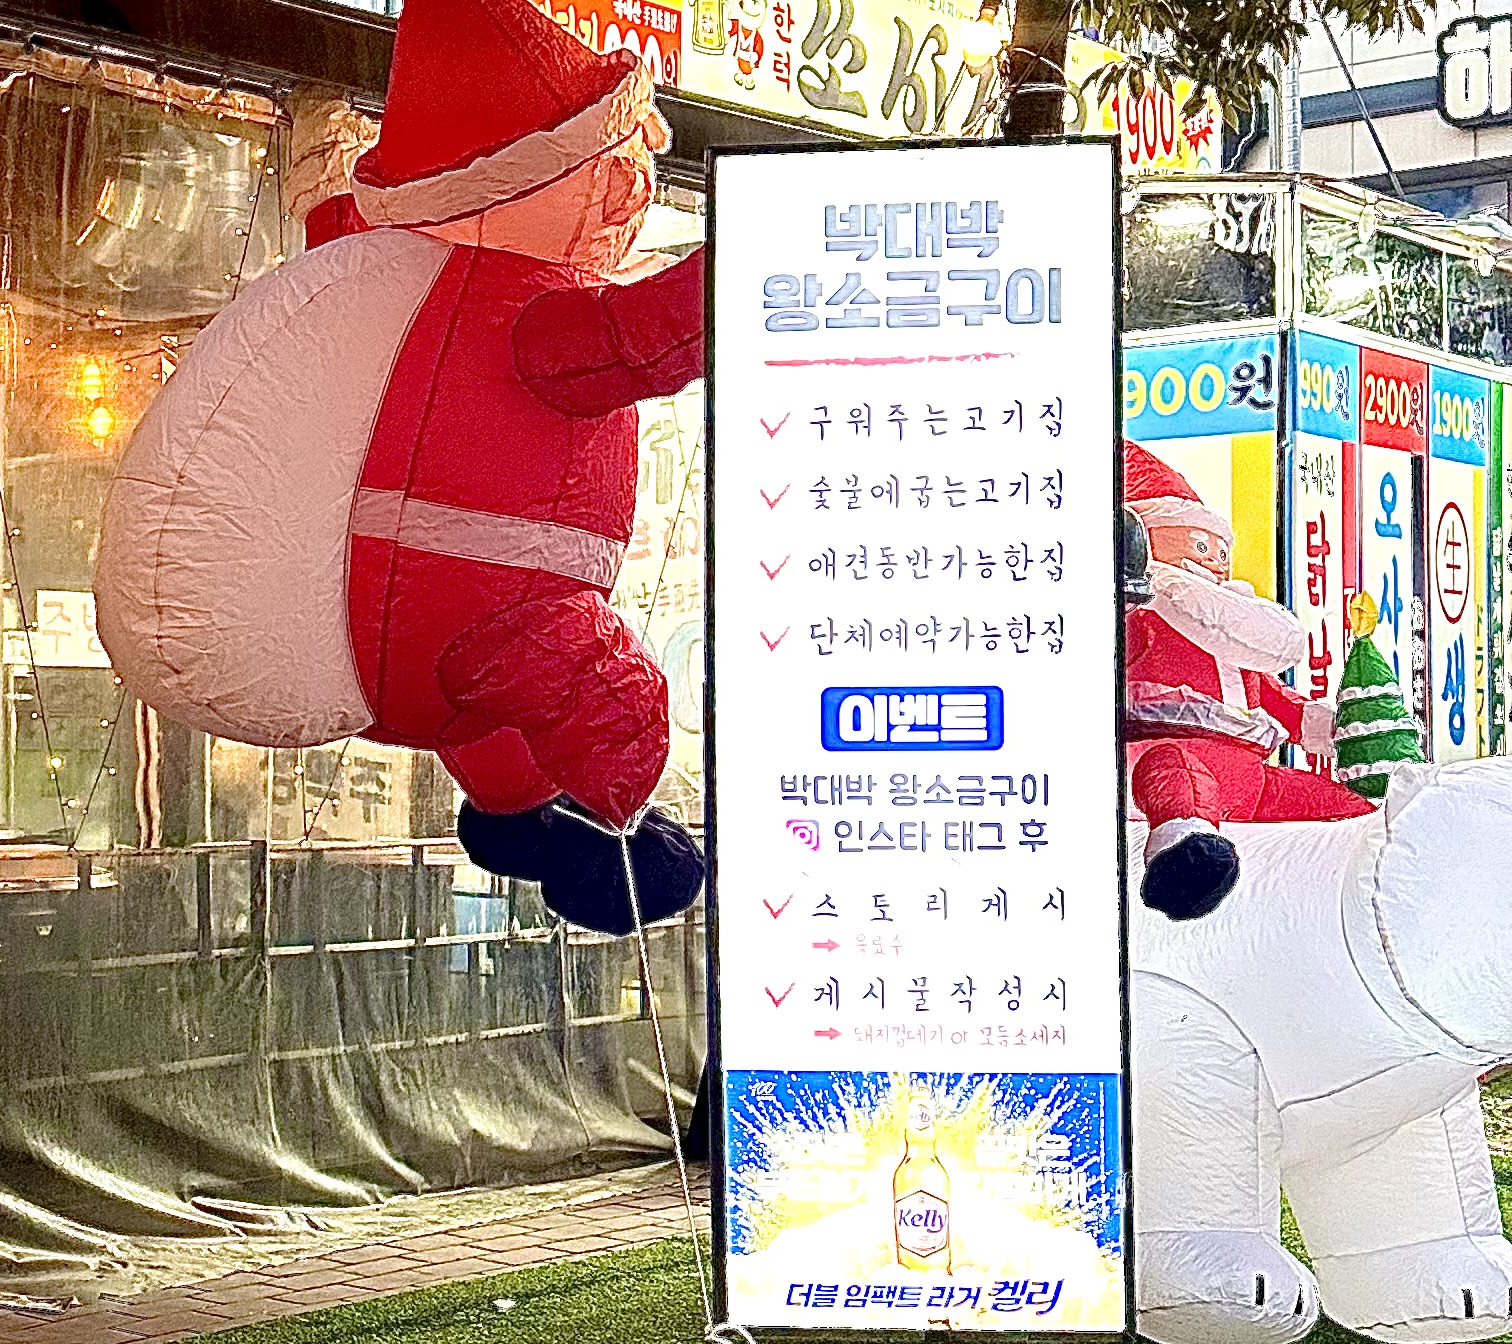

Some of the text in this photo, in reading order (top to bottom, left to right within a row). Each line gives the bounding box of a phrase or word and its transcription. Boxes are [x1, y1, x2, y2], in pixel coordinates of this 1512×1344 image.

[824, 200, 1004, 262] 박대박
[762, 267, 1062, 331] 왕소금구이
[1300, 359, 1350, 421] 990원
[1364, 373, 1425, 436] 2900원
[808, 397, 1065, 442] 구워주는고기집
[1432, 389, 1486, 449] 1900원
[808, 469, 1065, 511] 숯불에굽는고기집
[808, 541, 1065, 584] 애견동반가능한집
[808, 613, 1065, 656] 단체예약가능한집
[838, 693, 987, 743] 이벤트
[780, 773, 1049, 807] 박대박 왕소금구이
[834, 818, 1049, 853] 인스타 태그 후
[951, 1030, 969, 1044] or
[899, 1208, 947, 1234] Kelly
[785, 1278, 1065, 1316] 더블 임팩트 라거 켈리
